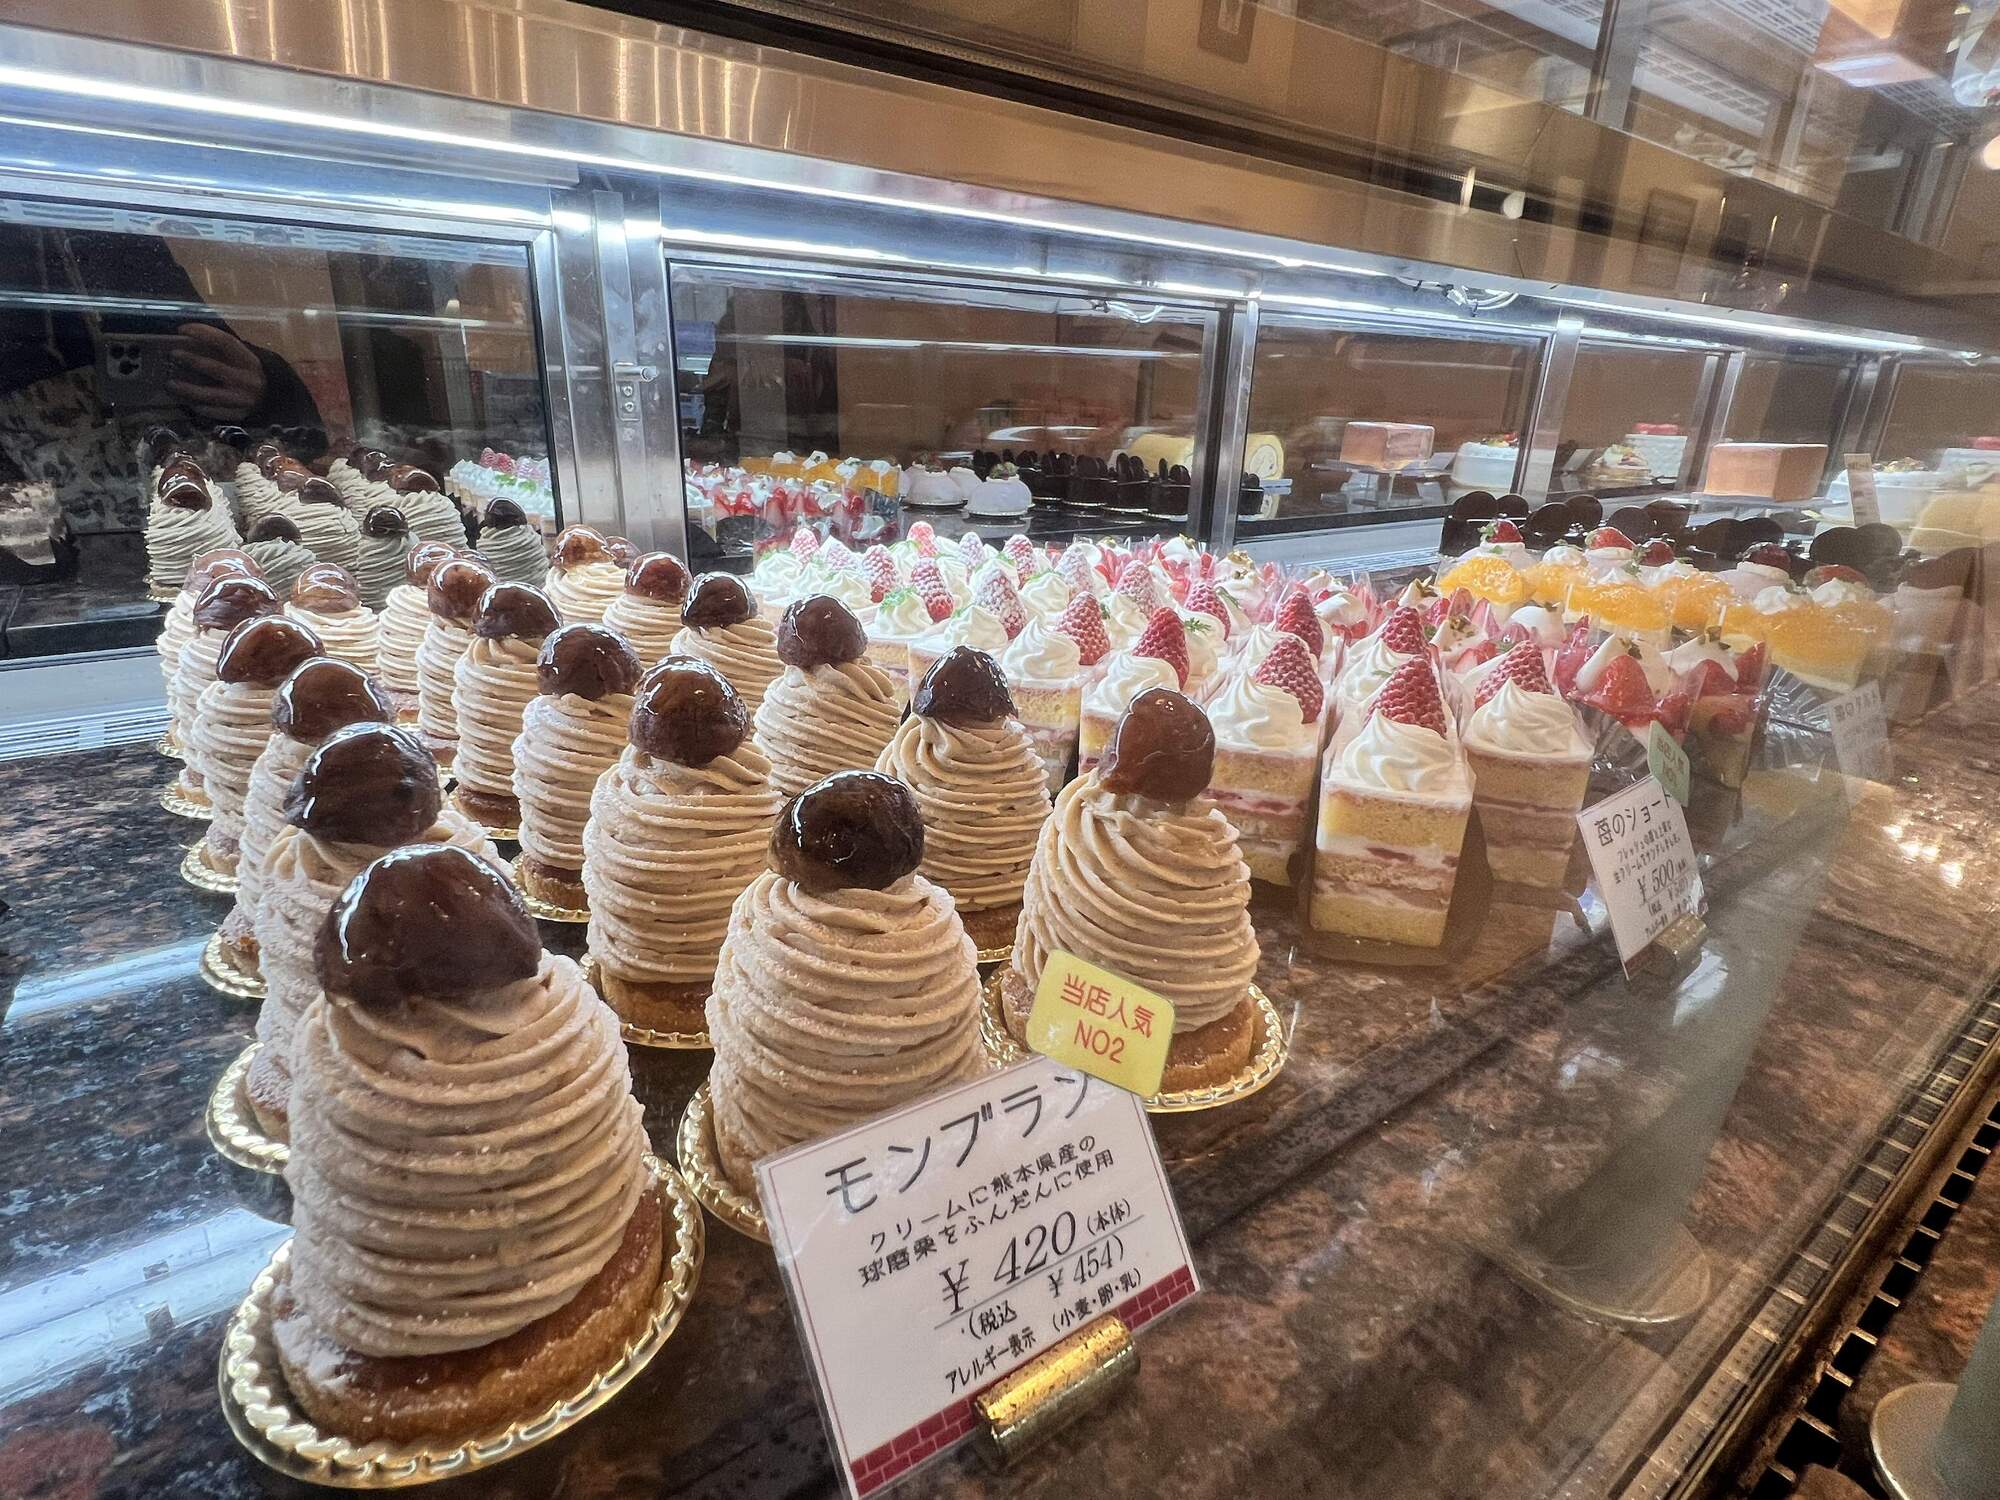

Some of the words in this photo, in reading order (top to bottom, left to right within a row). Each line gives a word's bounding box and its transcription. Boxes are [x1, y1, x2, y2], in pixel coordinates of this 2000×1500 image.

[1060, 973, 1156, 1038] 当店人気
[1073, 1019, 1127, 1064] NO2
[825, 1073, 1088, 1214] モンブラン
[858, 1149, 1114, 1287] 球磨栗をふんだんに使用
[870, 1135, 1095, 1253] クリームに熊本県産の
[994, 1211, 1076, 1284] 420
[945, 1326, 1037, 1394] アレルギー表示
